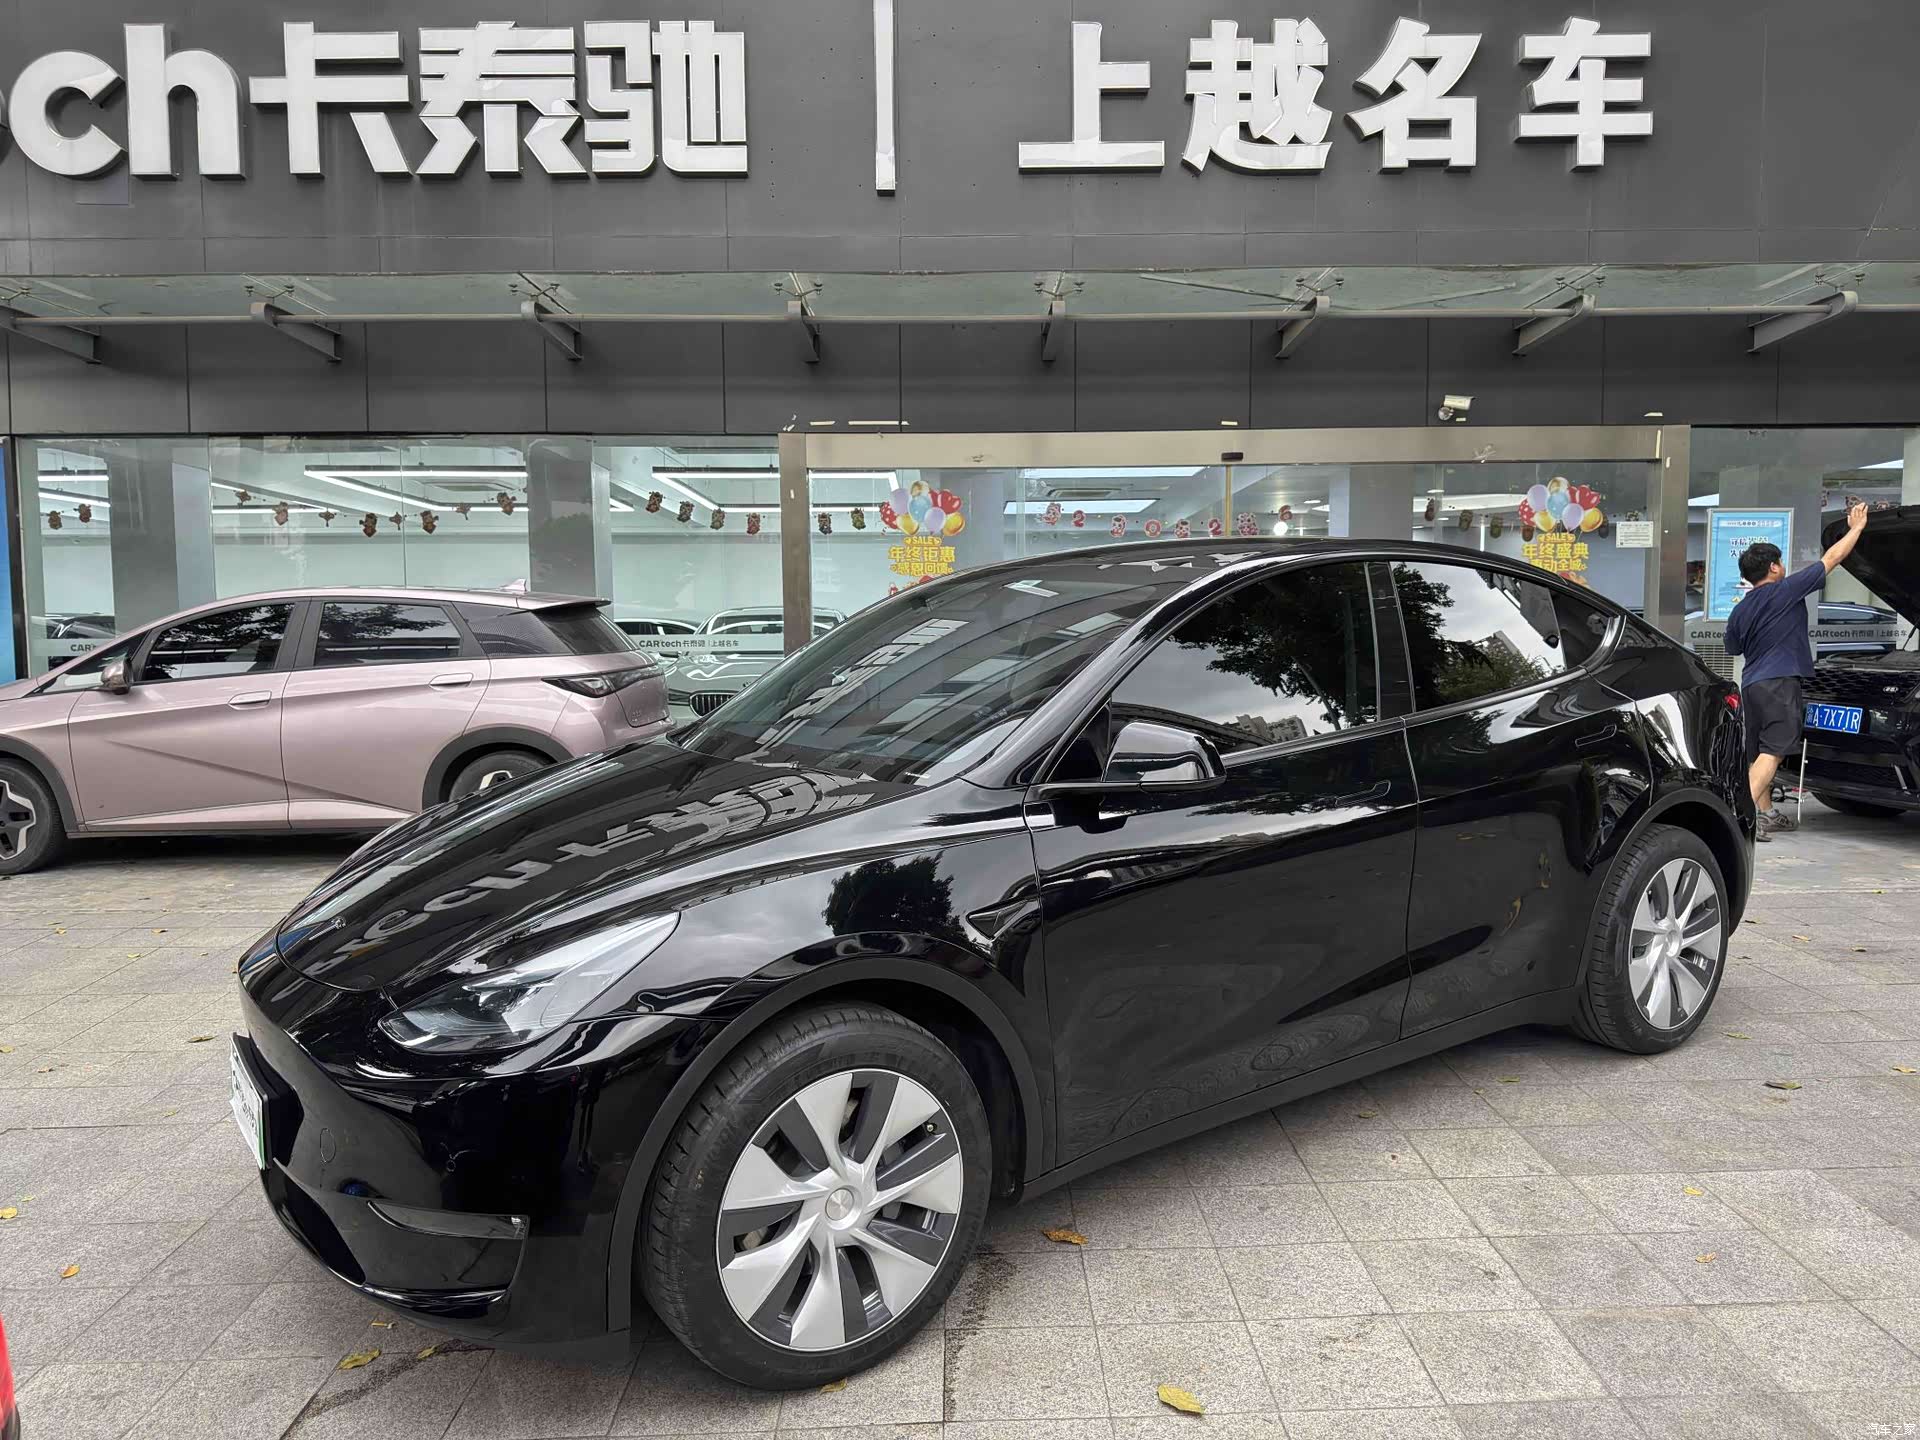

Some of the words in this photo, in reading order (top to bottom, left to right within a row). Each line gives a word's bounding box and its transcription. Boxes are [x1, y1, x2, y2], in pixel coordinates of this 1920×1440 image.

[0, 22, 244, 178] ch
[249, 20, 749, 178] 卡泰驰
[1017, 16, 1653, 173] 上越名车
[912, 536, 933, 545] SALE
[1545, 533, 1568, 542] SALE
[888, 546, 956, 563] 年终钜惠
[1522, 543, 1589, 559] 年终盛典
